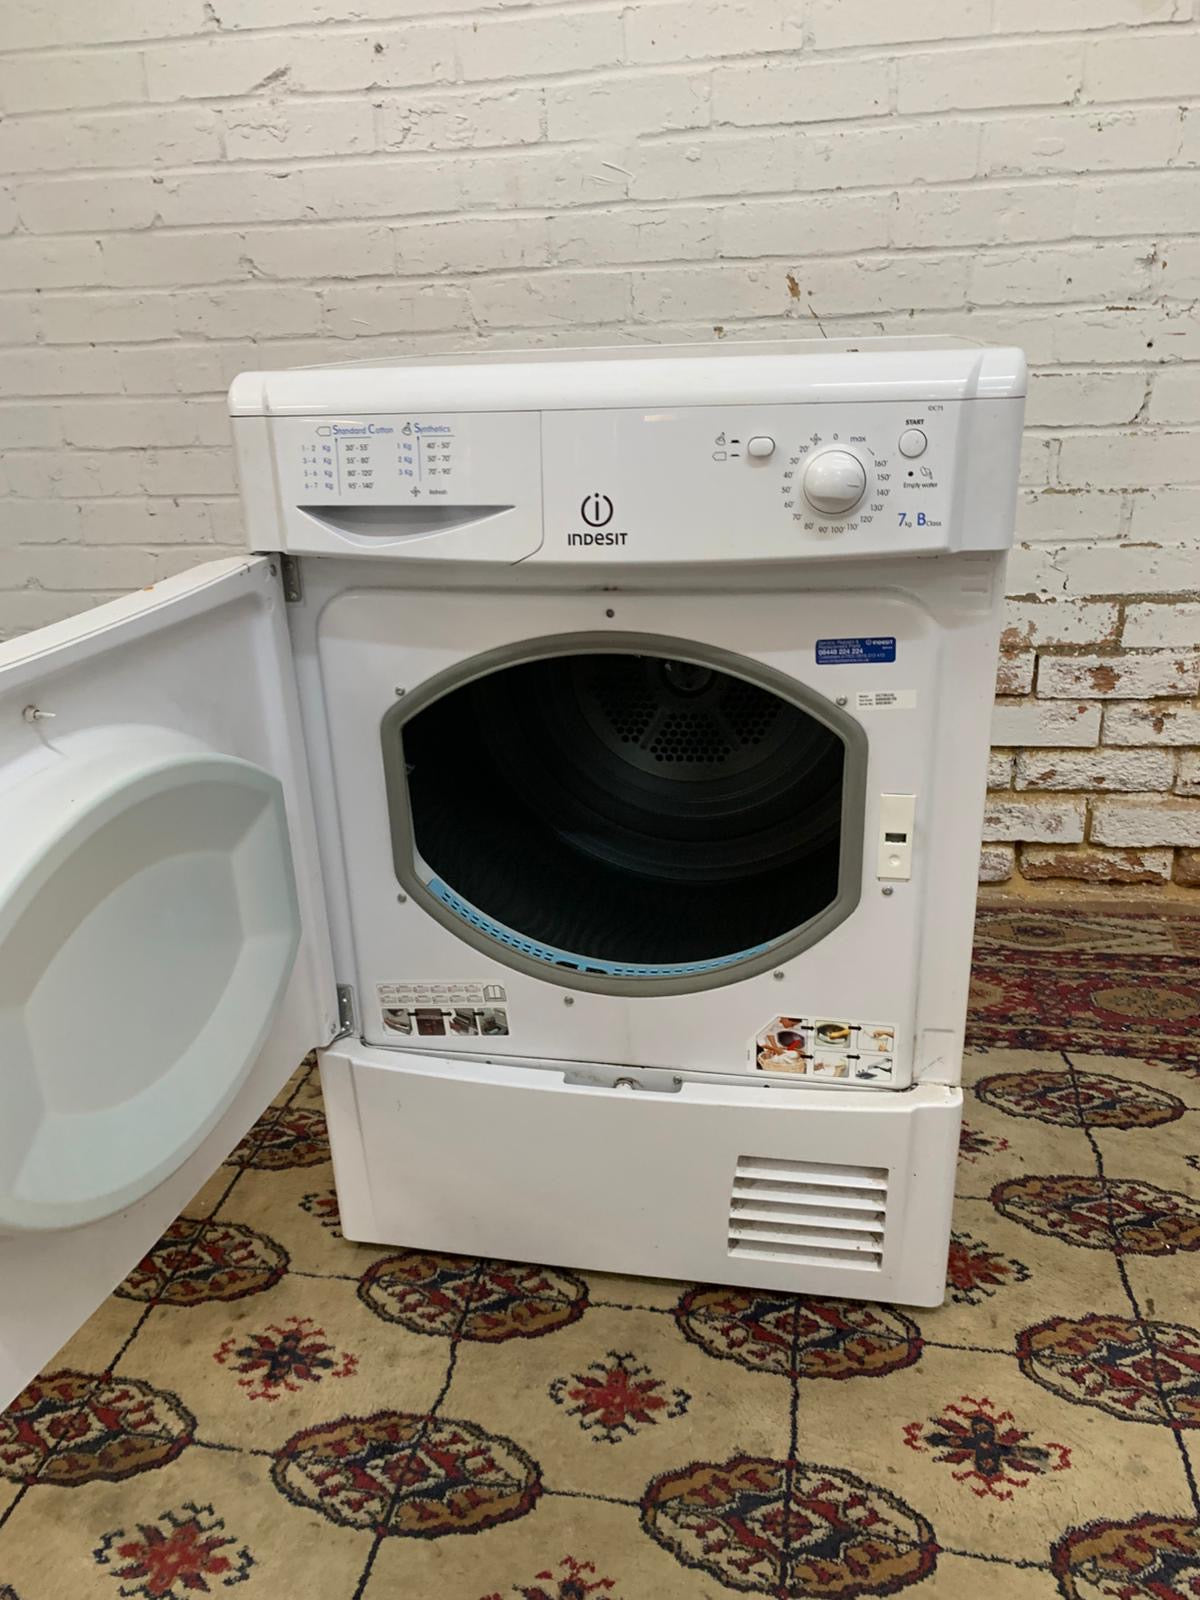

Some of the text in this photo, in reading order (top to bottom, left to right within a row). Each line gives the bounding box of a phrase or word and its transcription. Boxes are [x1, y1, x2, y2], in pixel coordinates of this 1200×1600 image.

[905, 418, 924, 426] START
[332, 424, 394, 435] Standard Cotton
[414, 422, 451, 434] Synthetics
[902, 482, 920, 490] Empty
